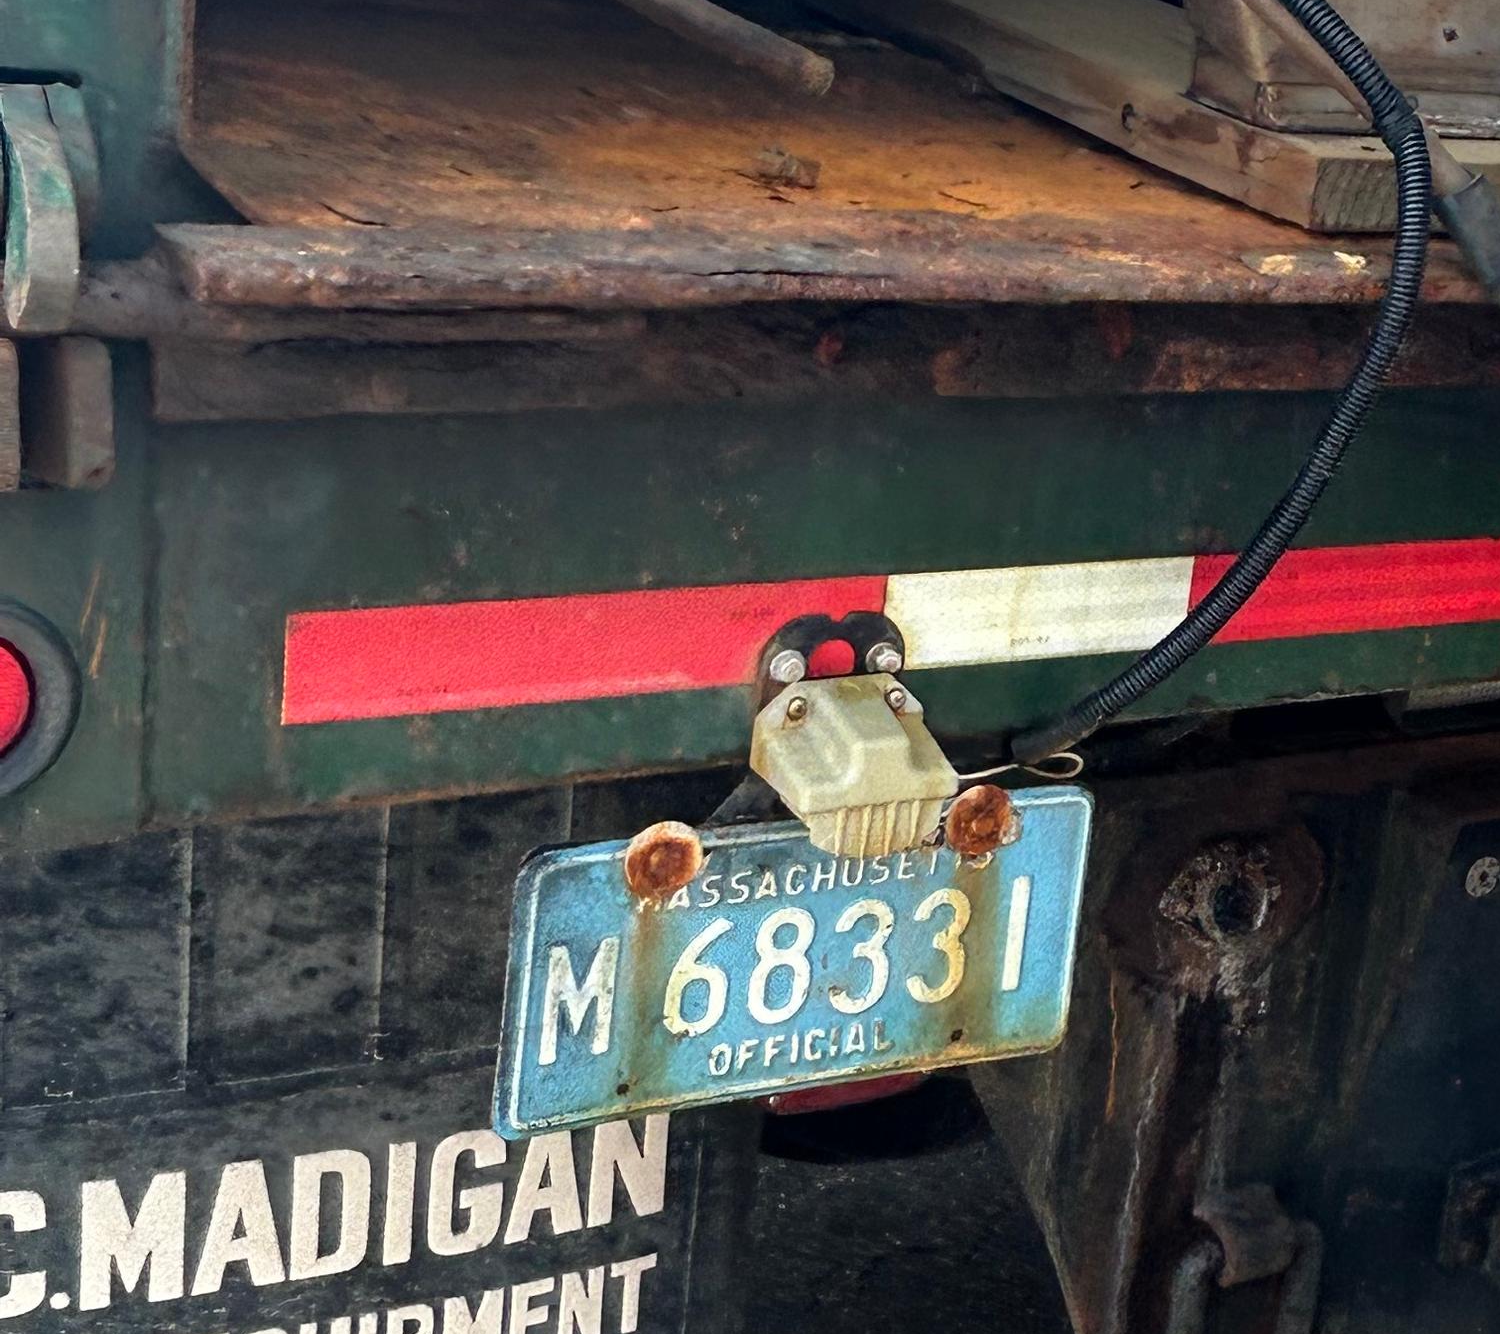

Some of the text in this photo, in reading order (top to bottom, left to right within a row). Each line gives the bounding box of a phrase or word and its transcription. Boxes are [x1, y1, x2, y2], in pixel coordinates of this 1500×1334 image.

[538, 876, 1032, 1067] M 68331
[708, 1017, 895, 1077] OFFICIAL
